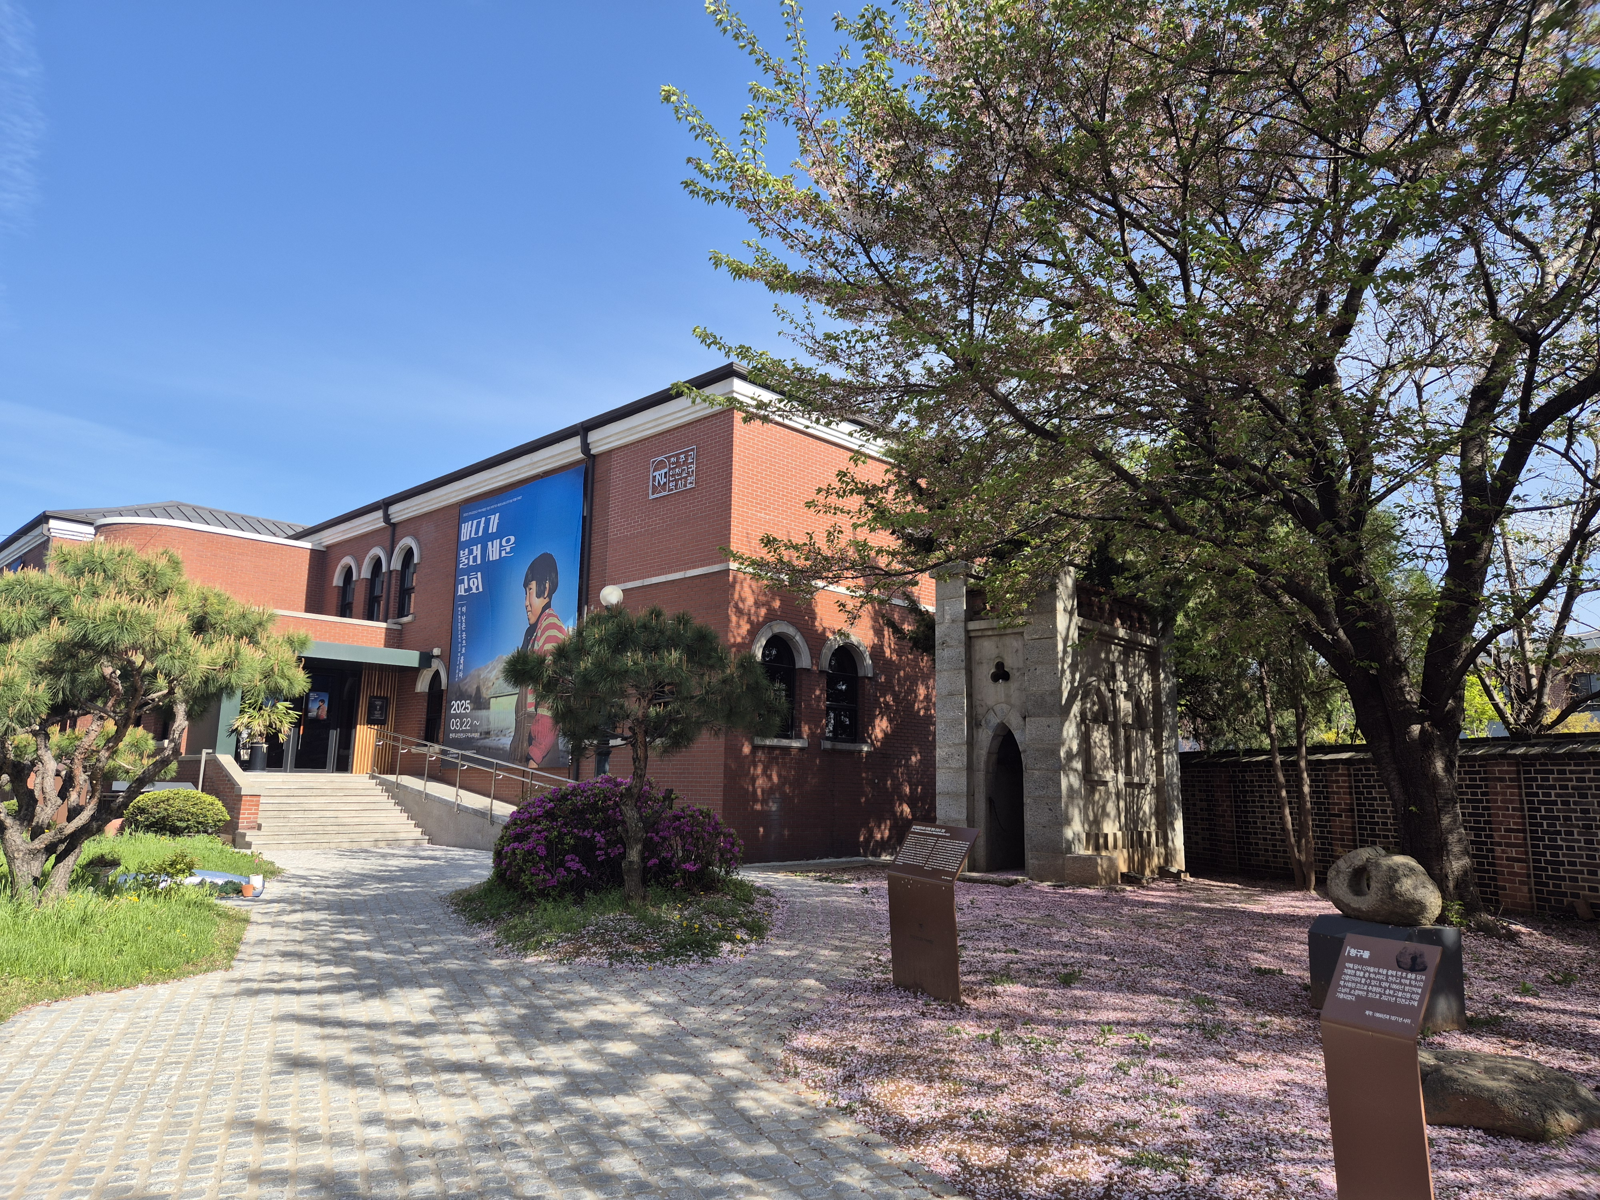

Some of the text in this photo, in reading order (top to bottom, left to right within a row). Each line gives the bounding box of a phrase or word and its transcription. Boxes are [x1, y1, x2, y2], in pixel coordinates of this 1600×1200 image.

[461, 513, 500, 541] 바다가
[459, 536, 515, 569] 불러 세운
[457, 572, 483, 596] 교회
[451, 700, 470, 713] 2025
[450, 718, 471, 730] 03.22
